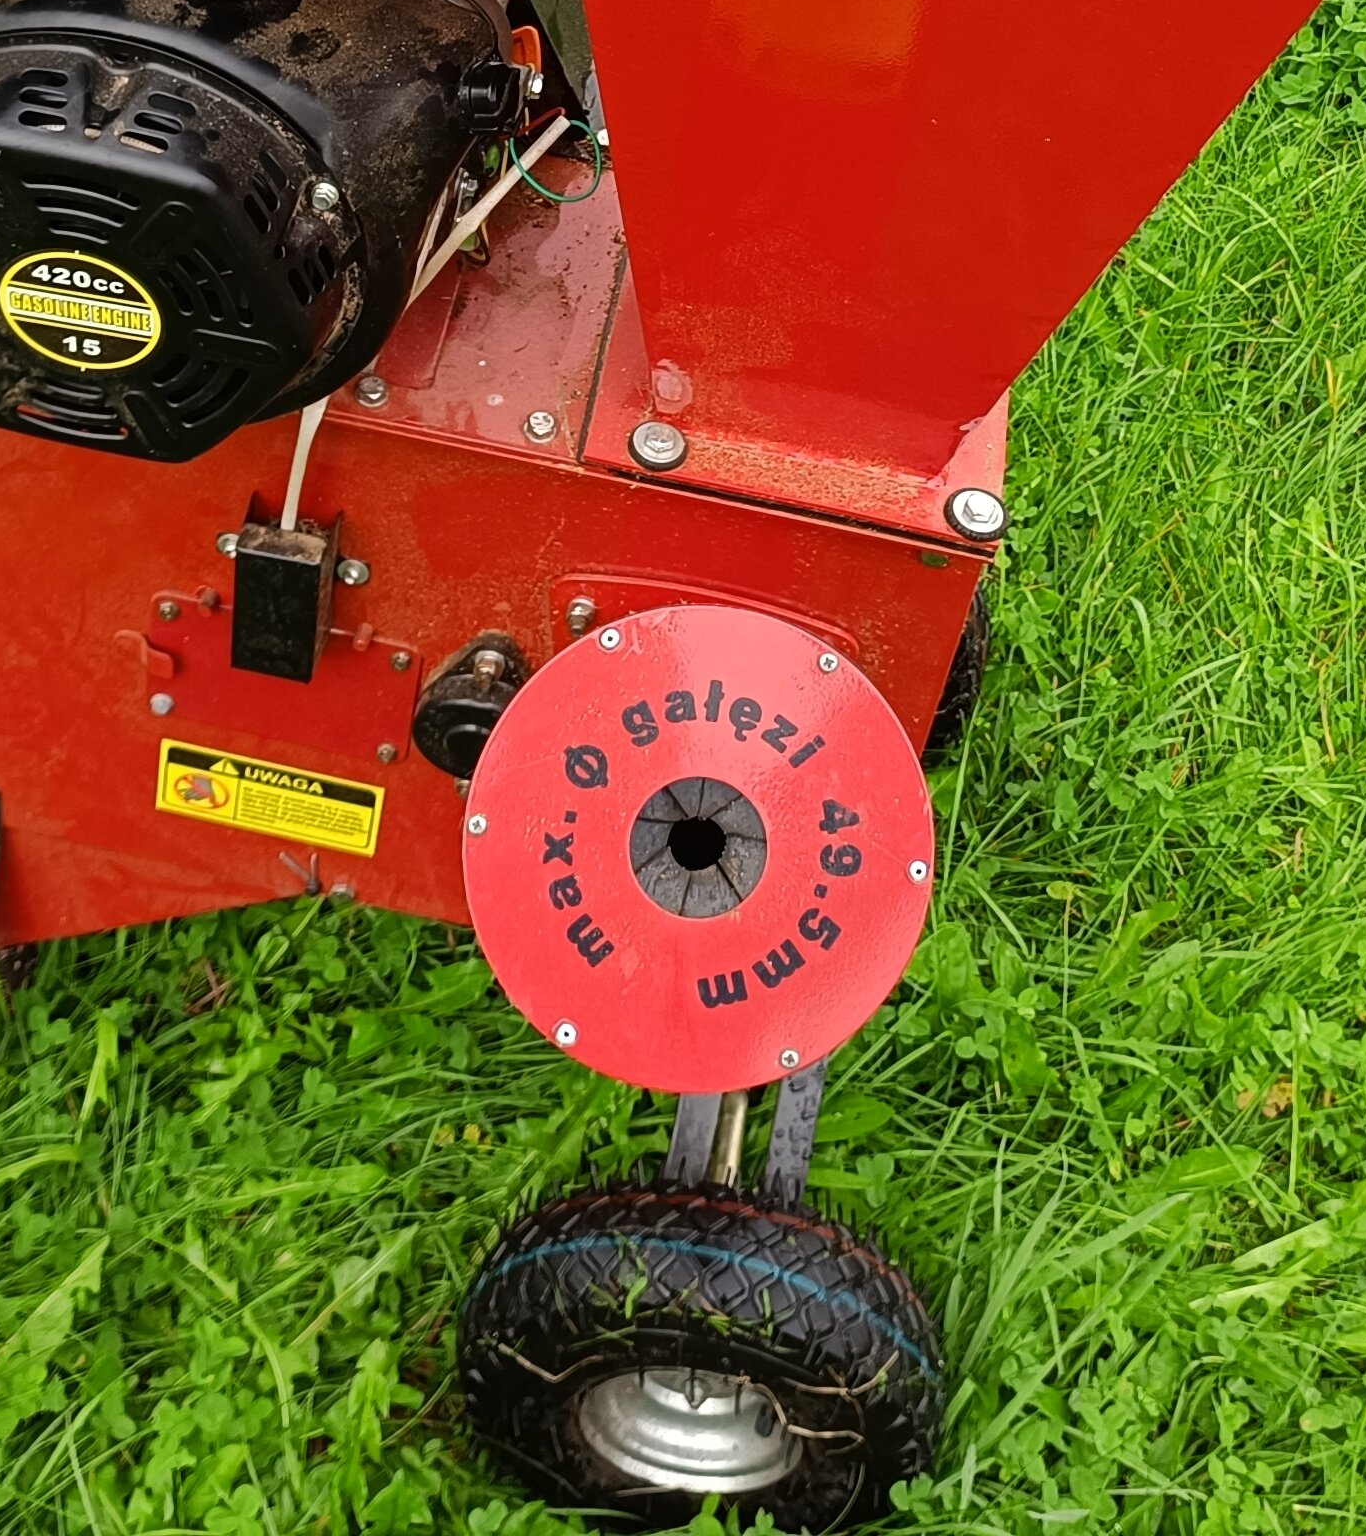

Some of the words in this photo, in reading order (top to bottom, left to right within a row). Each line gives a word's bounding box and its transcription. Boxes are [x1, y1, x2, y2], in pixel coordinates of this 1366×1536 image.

[31, 264, 125, 294] 420cc
[9, 291, 91, 321] GASOLINE
[91, 305, 152, 331] ENGINE
[62, 335, 102, 356] 15
[621, 679, 826, 769] gałęzi
[244, 766, 324, 795] UWAGA
[542, 809, 615, 968] max.
[696, 798, 862, 1009] 49.5mm
